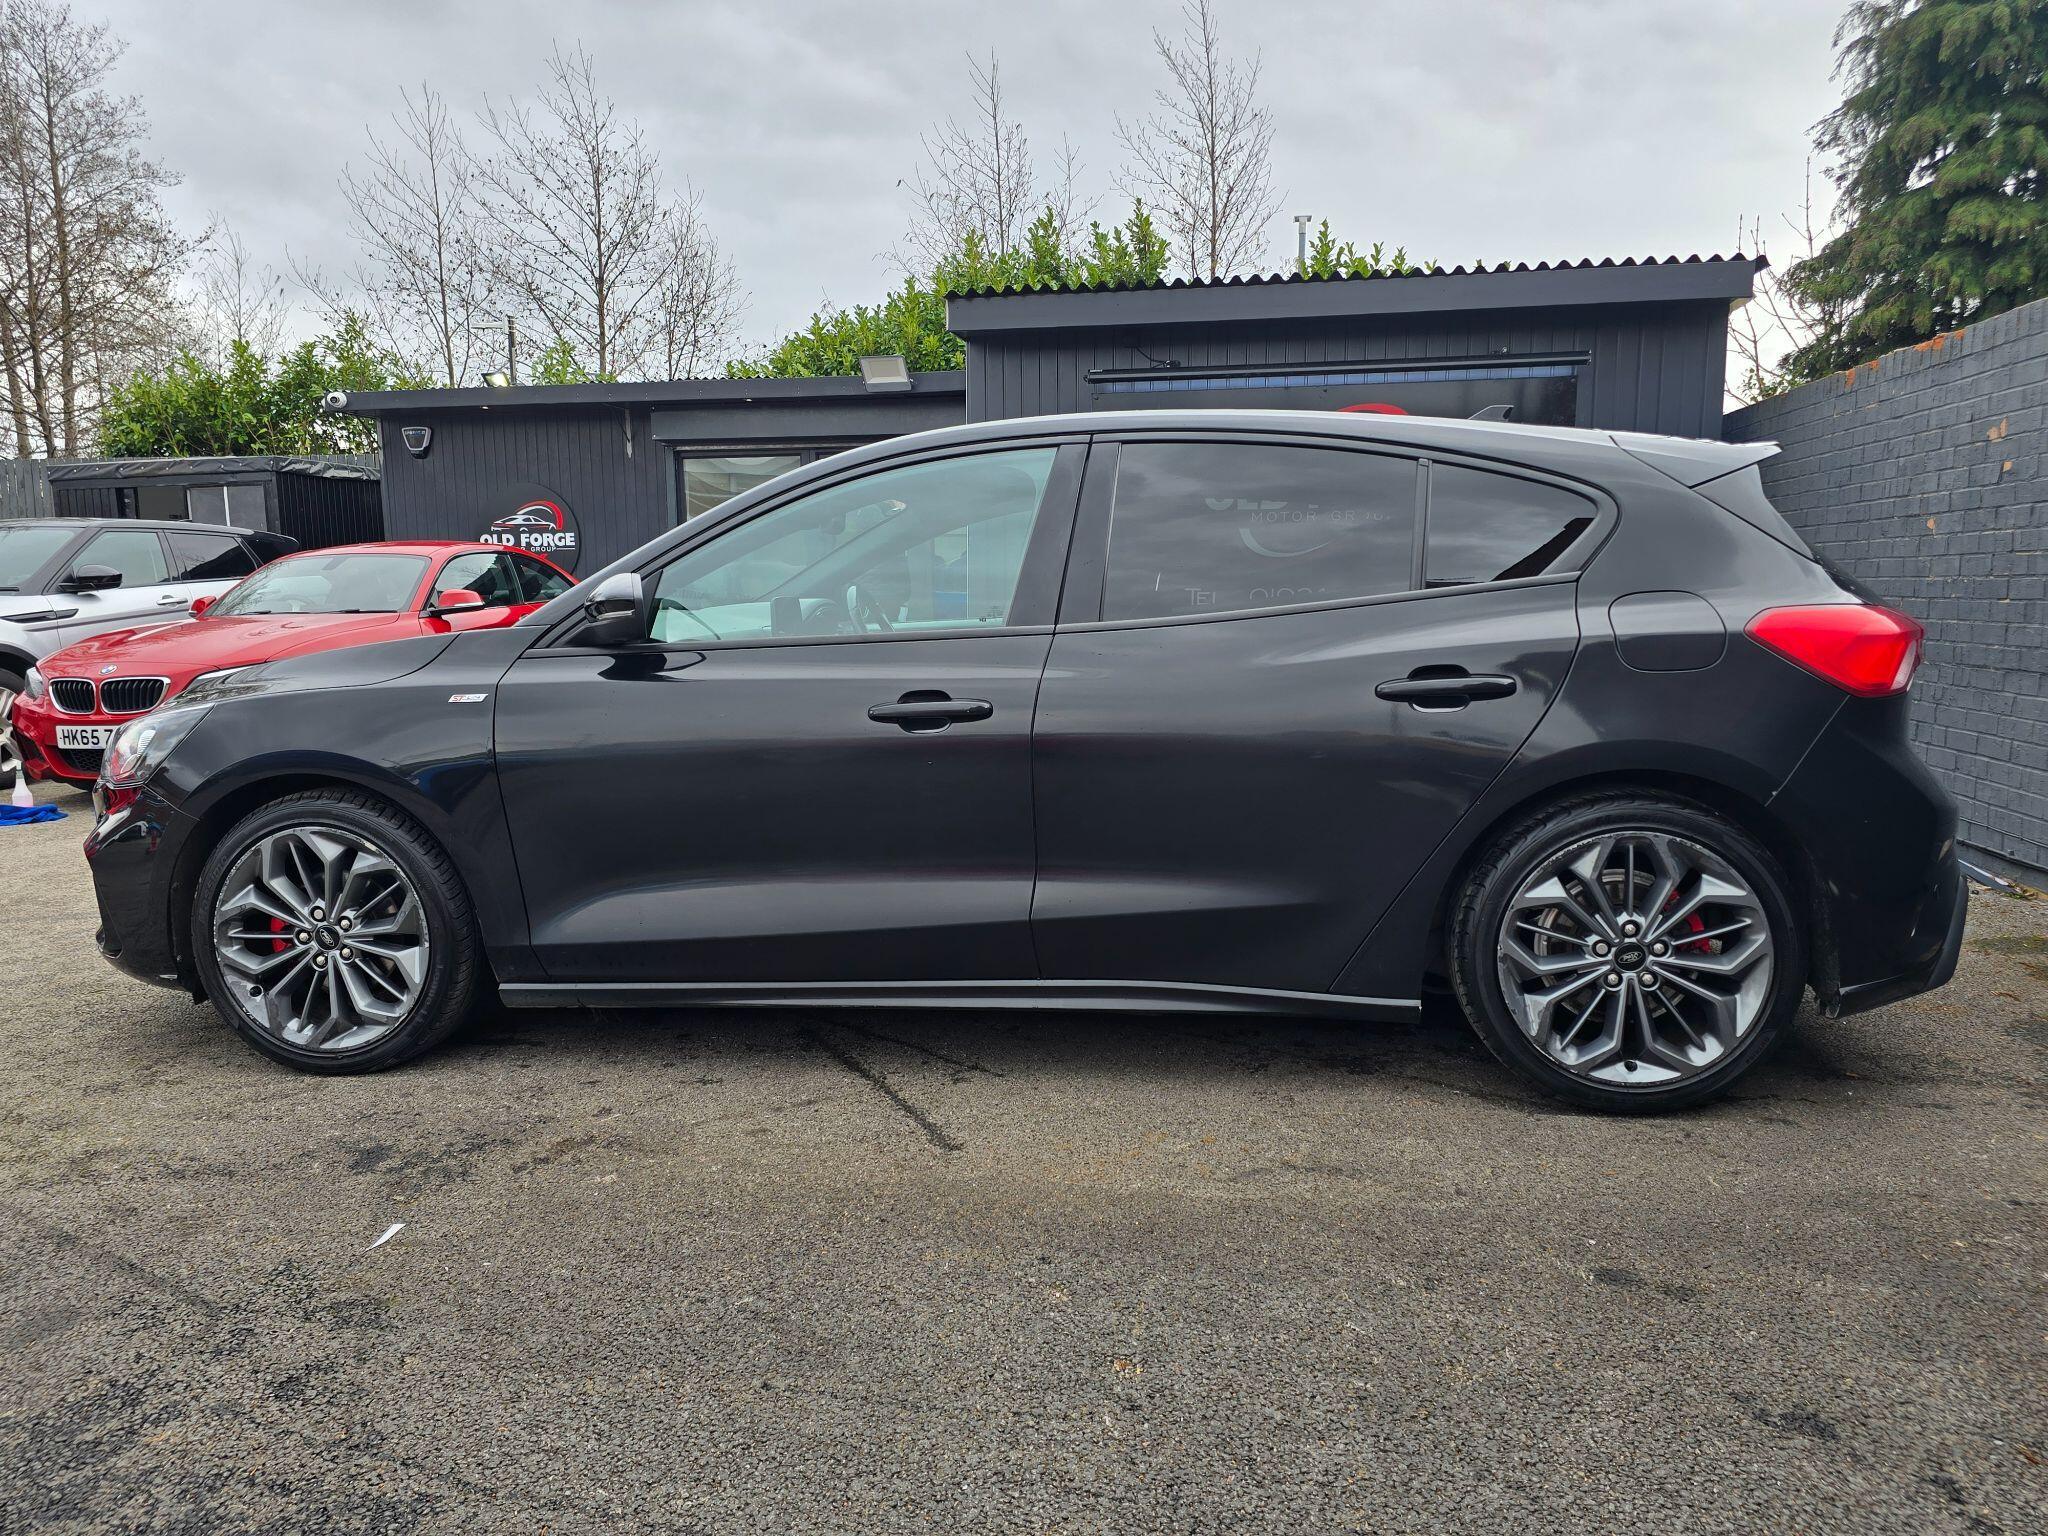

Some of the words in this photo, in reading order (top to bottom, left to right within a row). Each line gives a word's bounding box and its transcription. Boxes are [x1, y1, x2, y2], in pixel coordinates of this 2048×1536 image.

[1251, 511, 1319, 521] MOTOR
[479, 533, 515, 547] OLD
[520, 532, 576, 546] FORGE
[62, 729, 100, 745] HK65
